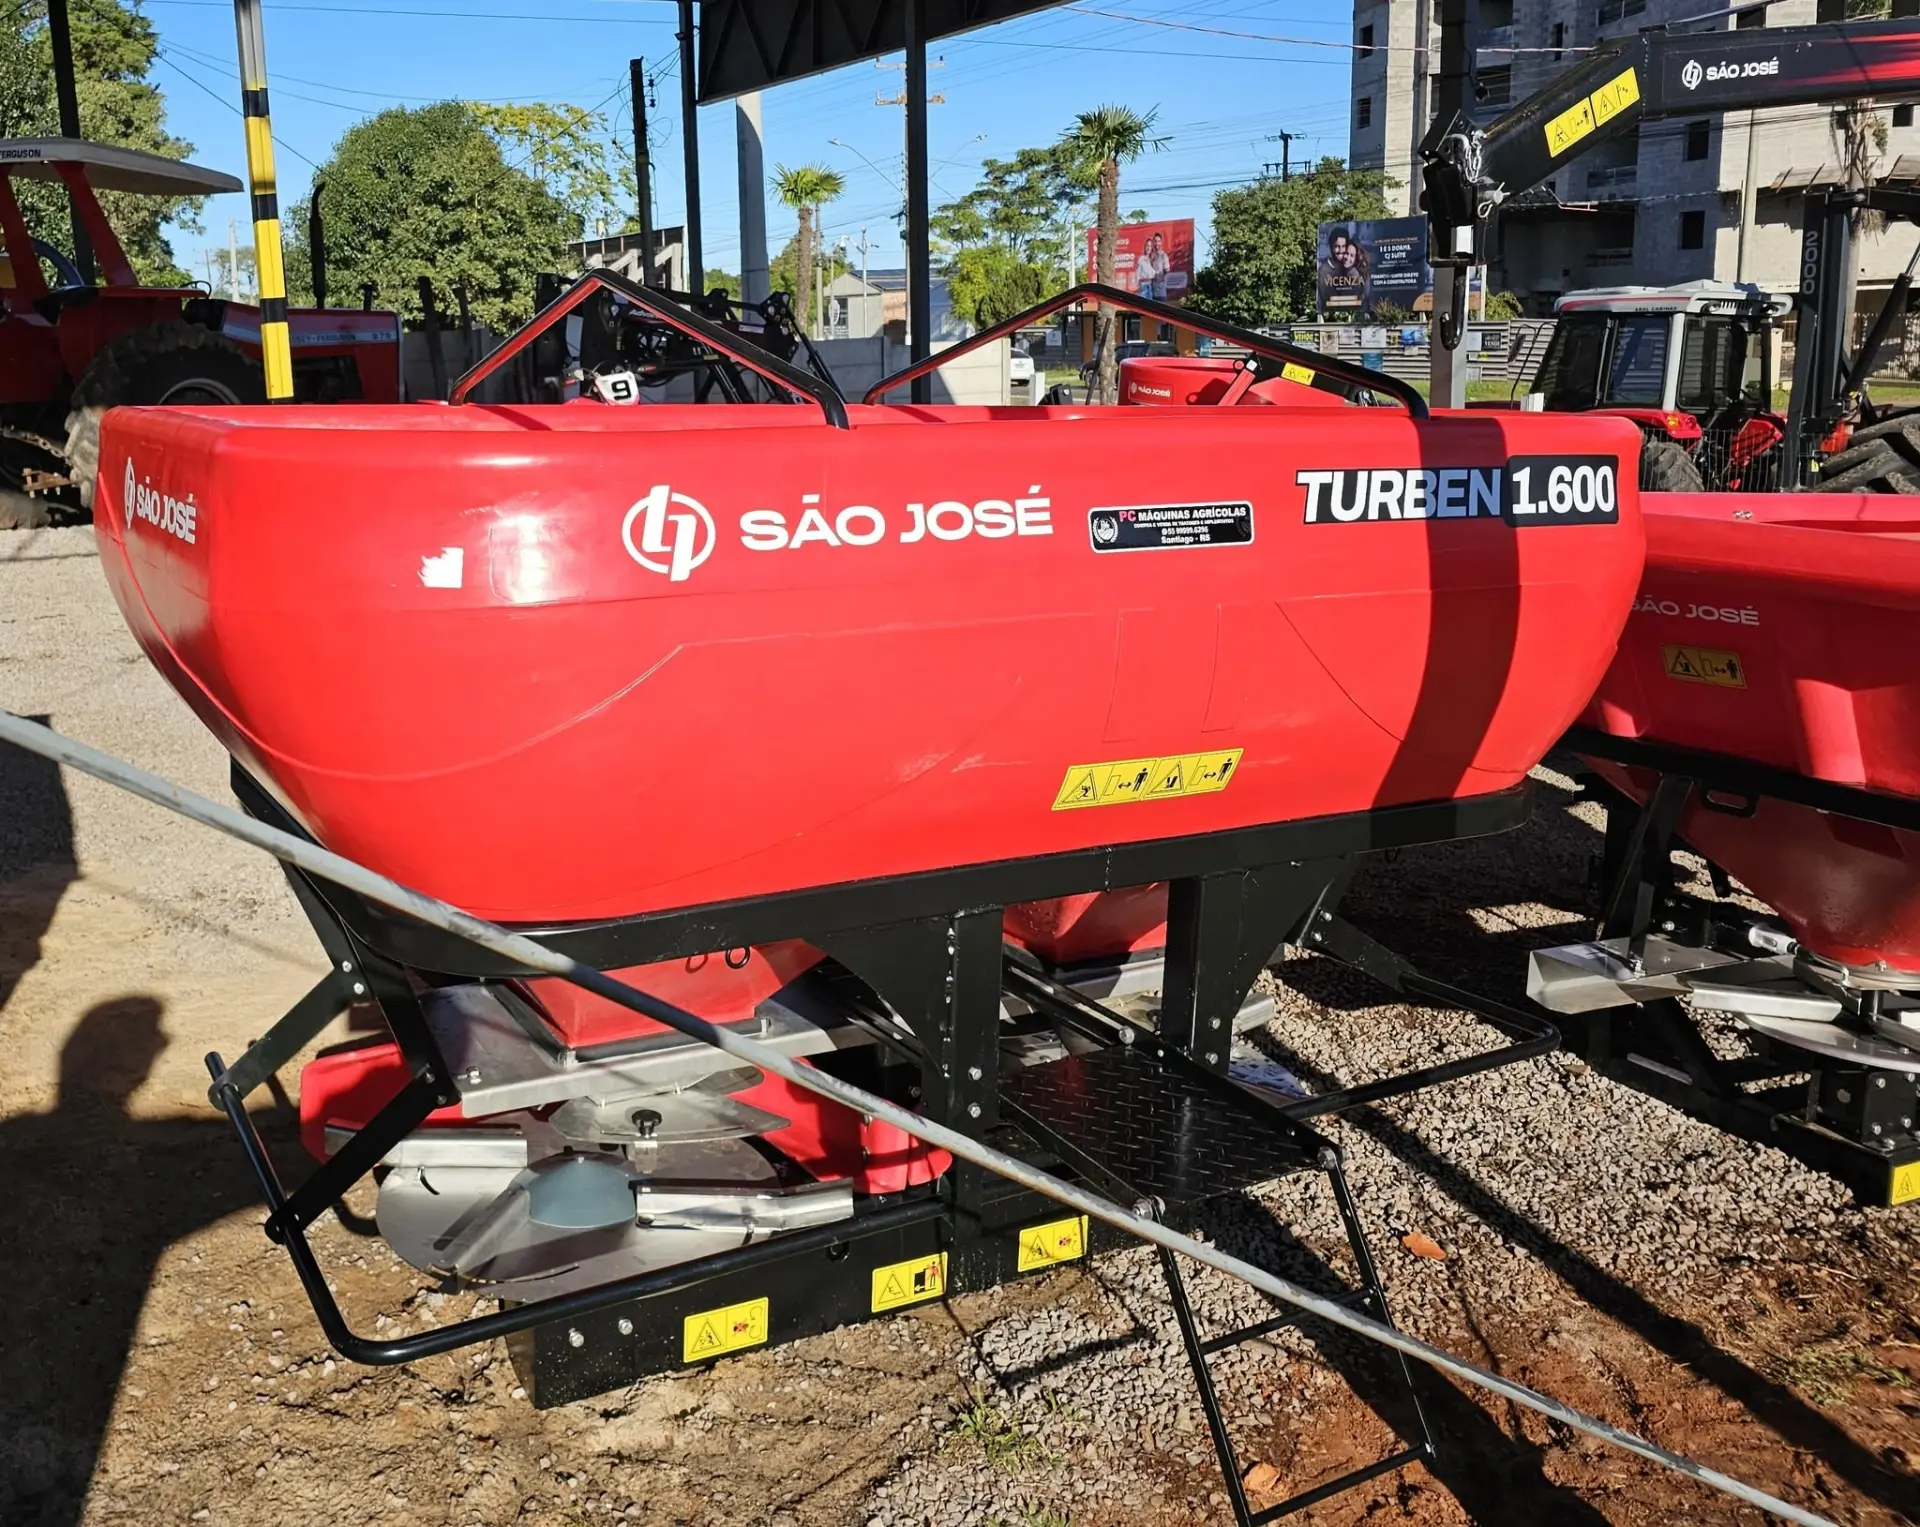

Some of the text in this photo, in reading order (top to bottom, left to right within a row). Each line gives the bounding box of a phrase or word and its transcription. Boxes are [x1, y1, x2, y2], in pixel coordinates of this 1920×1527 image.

[1706, 56, 1779, 81] SÃO JOSÉ
[0, 149, 41, 159] ERGUSON
[1803, 231, 1819, 294] 2000
[1324, 275, 1365, 287] VICENZA
[611, 380, 632, 401] 9
[1297, 465, 1615, 522] TURBEN 1.600
[137, 476, 196, 545] SÃO JOSÉ
[740, 485, 1053, 551] SÃO JOSÉ
[1119, 507, 1246, 522] PC MÁQUINAS AGRÍCOLAS
[1161, 535, 1194, 544] Santiago
[1200, 533, 1210, 542] RS
[1685, 605, 1760, 626] JOSÉ
